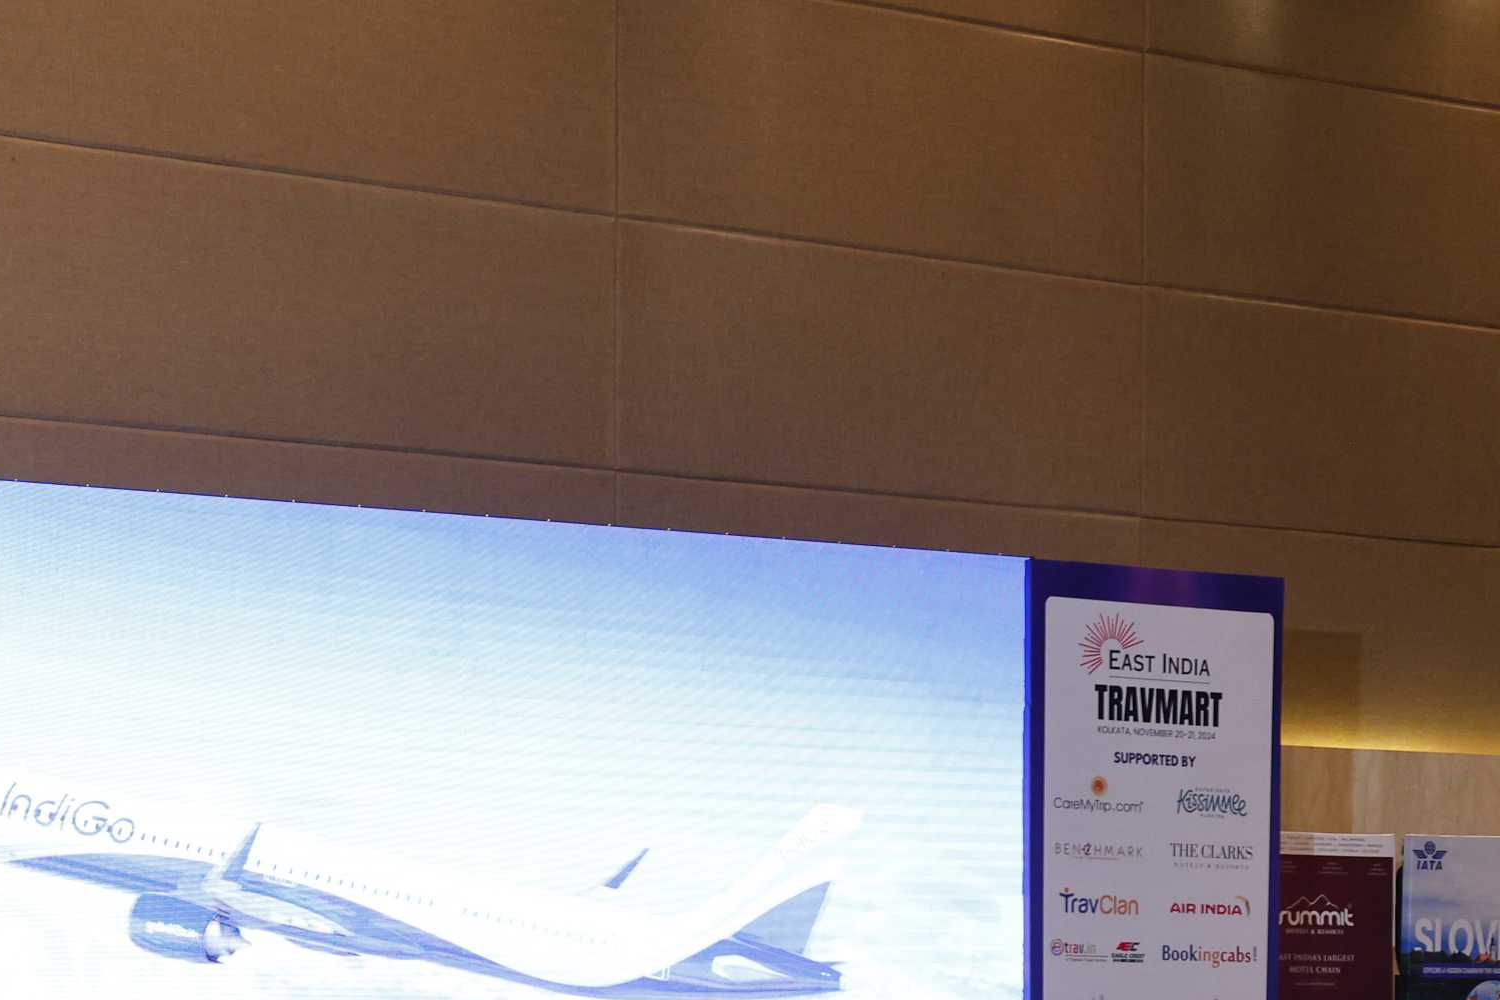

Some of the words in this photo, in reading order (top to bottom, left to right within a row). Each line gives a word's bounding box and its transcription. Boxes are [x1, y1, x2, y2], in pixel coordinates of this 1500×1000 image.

[1109, 650, 1155, 672] EAST
[1162, 653, 1211, 677] INDIA
[1094, 684, 1222, 727] TRAVMART
[1097, 726, 1132, 736] KOLKATA,
[1134, 728, 1172, 738] NOVEMBER
[1174, 730, 1196, 739] 20-21,
[1198, 732, 1216, 740] 2024
[1114, 752, 1180, 766] SUPPORTED
[1181, 755, 1196, 767] BY
[0, 782, 135, 844] IndiGo
[1170, 842, 1199, 858] THE
[1201, 844, 1254, 861] CLARKS
[1416, 860, 1443, 870] IATA
[1060, 893, 1139, 915] TravClan
[1170, 902, 1196, 914] AIR
[1201, 903, 1242, 915] INDIA
